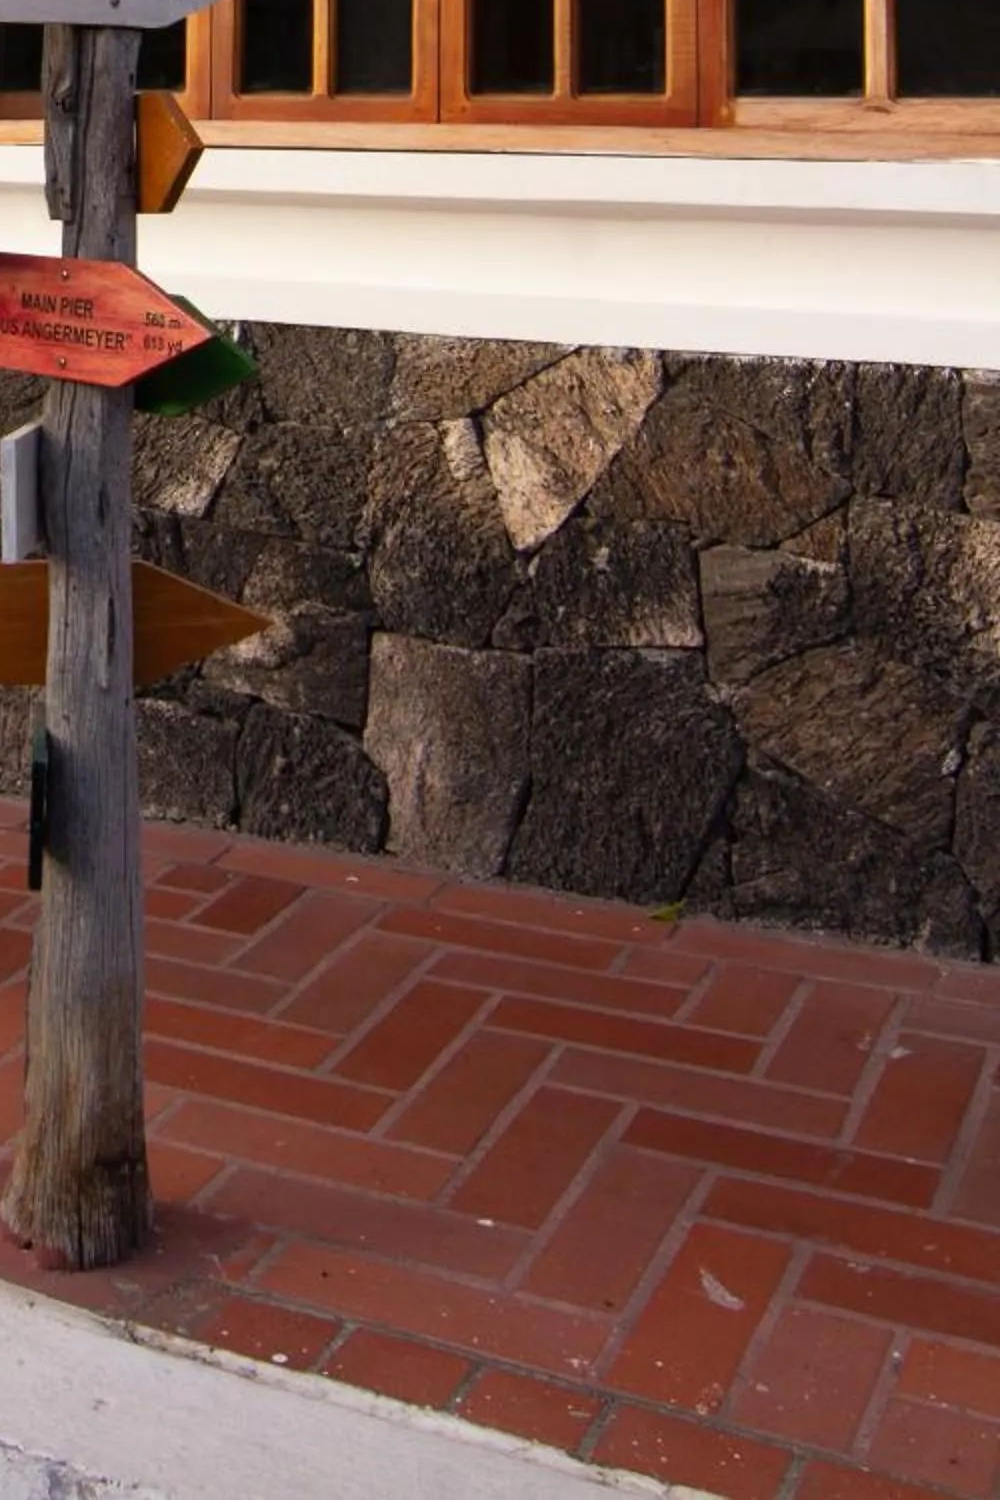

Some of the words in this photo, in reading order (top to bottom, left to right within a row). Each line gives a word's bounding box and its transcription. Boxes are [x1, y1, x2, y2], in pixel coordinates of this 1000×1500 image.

[21, 292, 58, 314] MAIN
[60, 298, 94, 320] PIER
[169, 319, 182, 330] m
[168, 338, 183, 356] yd
